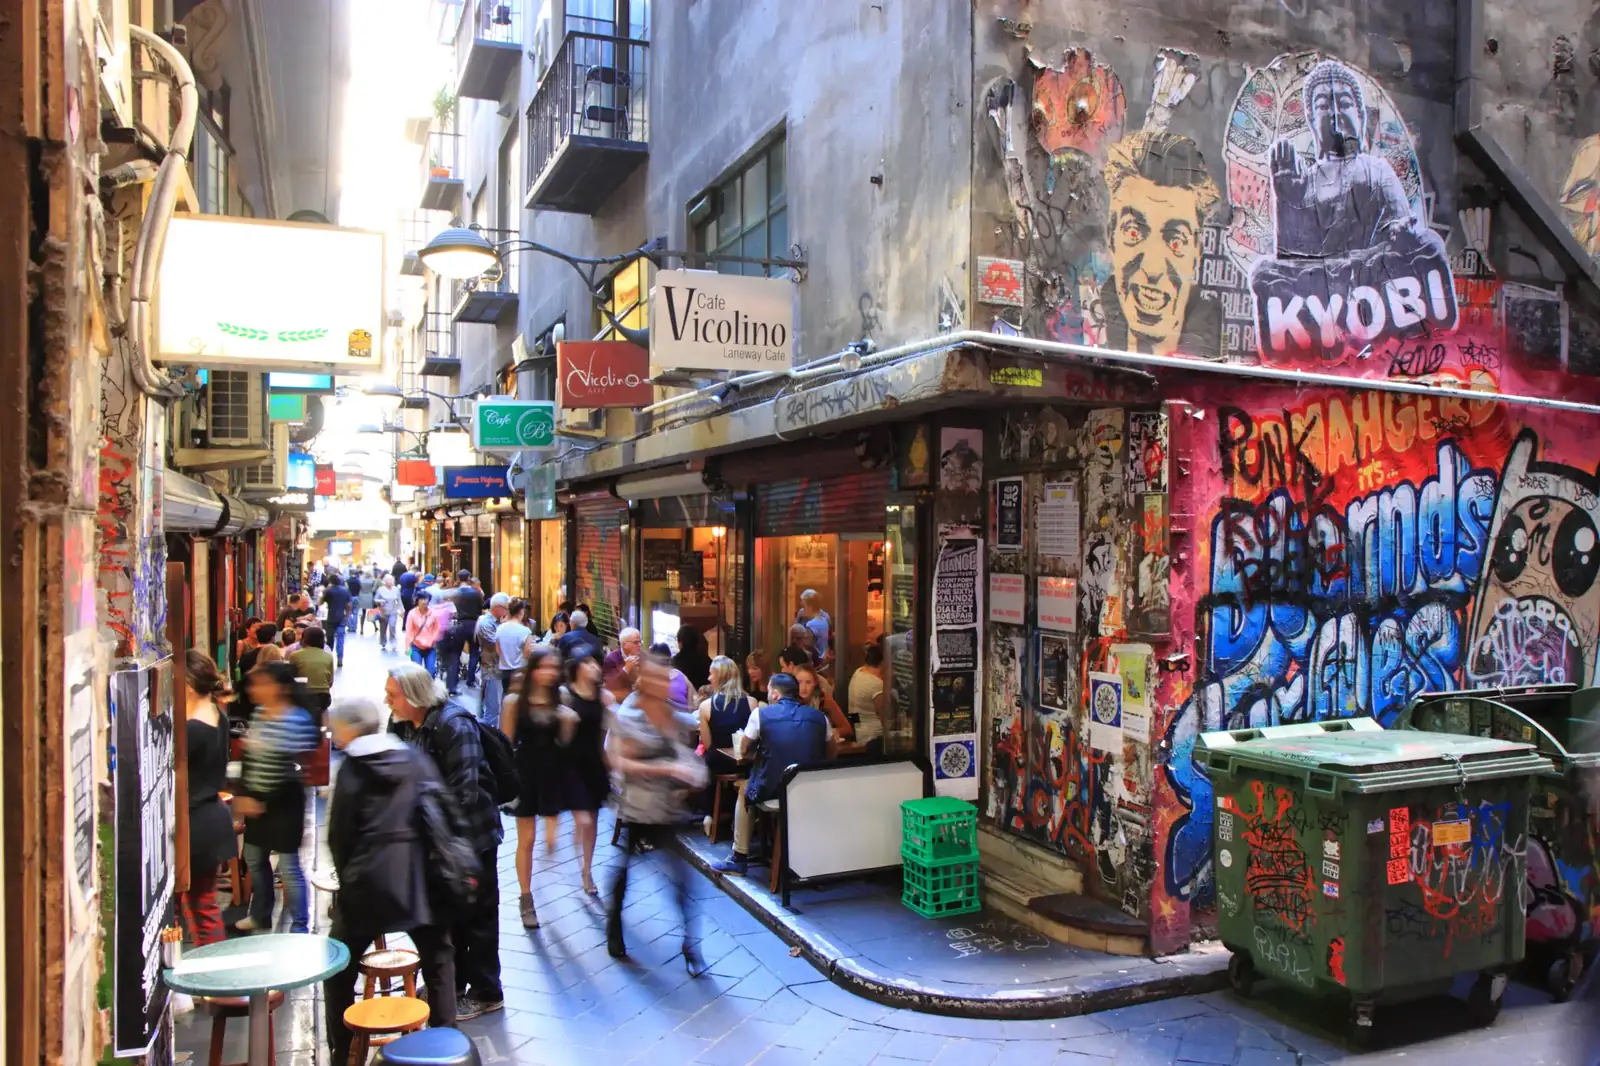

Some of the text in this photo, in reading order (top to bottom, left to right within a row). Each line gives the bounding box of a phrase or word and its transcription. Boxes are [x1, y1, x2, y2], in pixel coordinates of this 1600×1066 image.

[697, 293, 726, 310] Cafe
[1267, 269, 1448, 351] KYOBI
[662, 285, 786, 347] Vicolino
[723, 347, 786, 362] Laneway Cafe
[936, 605, 973, 613] DIALECT
